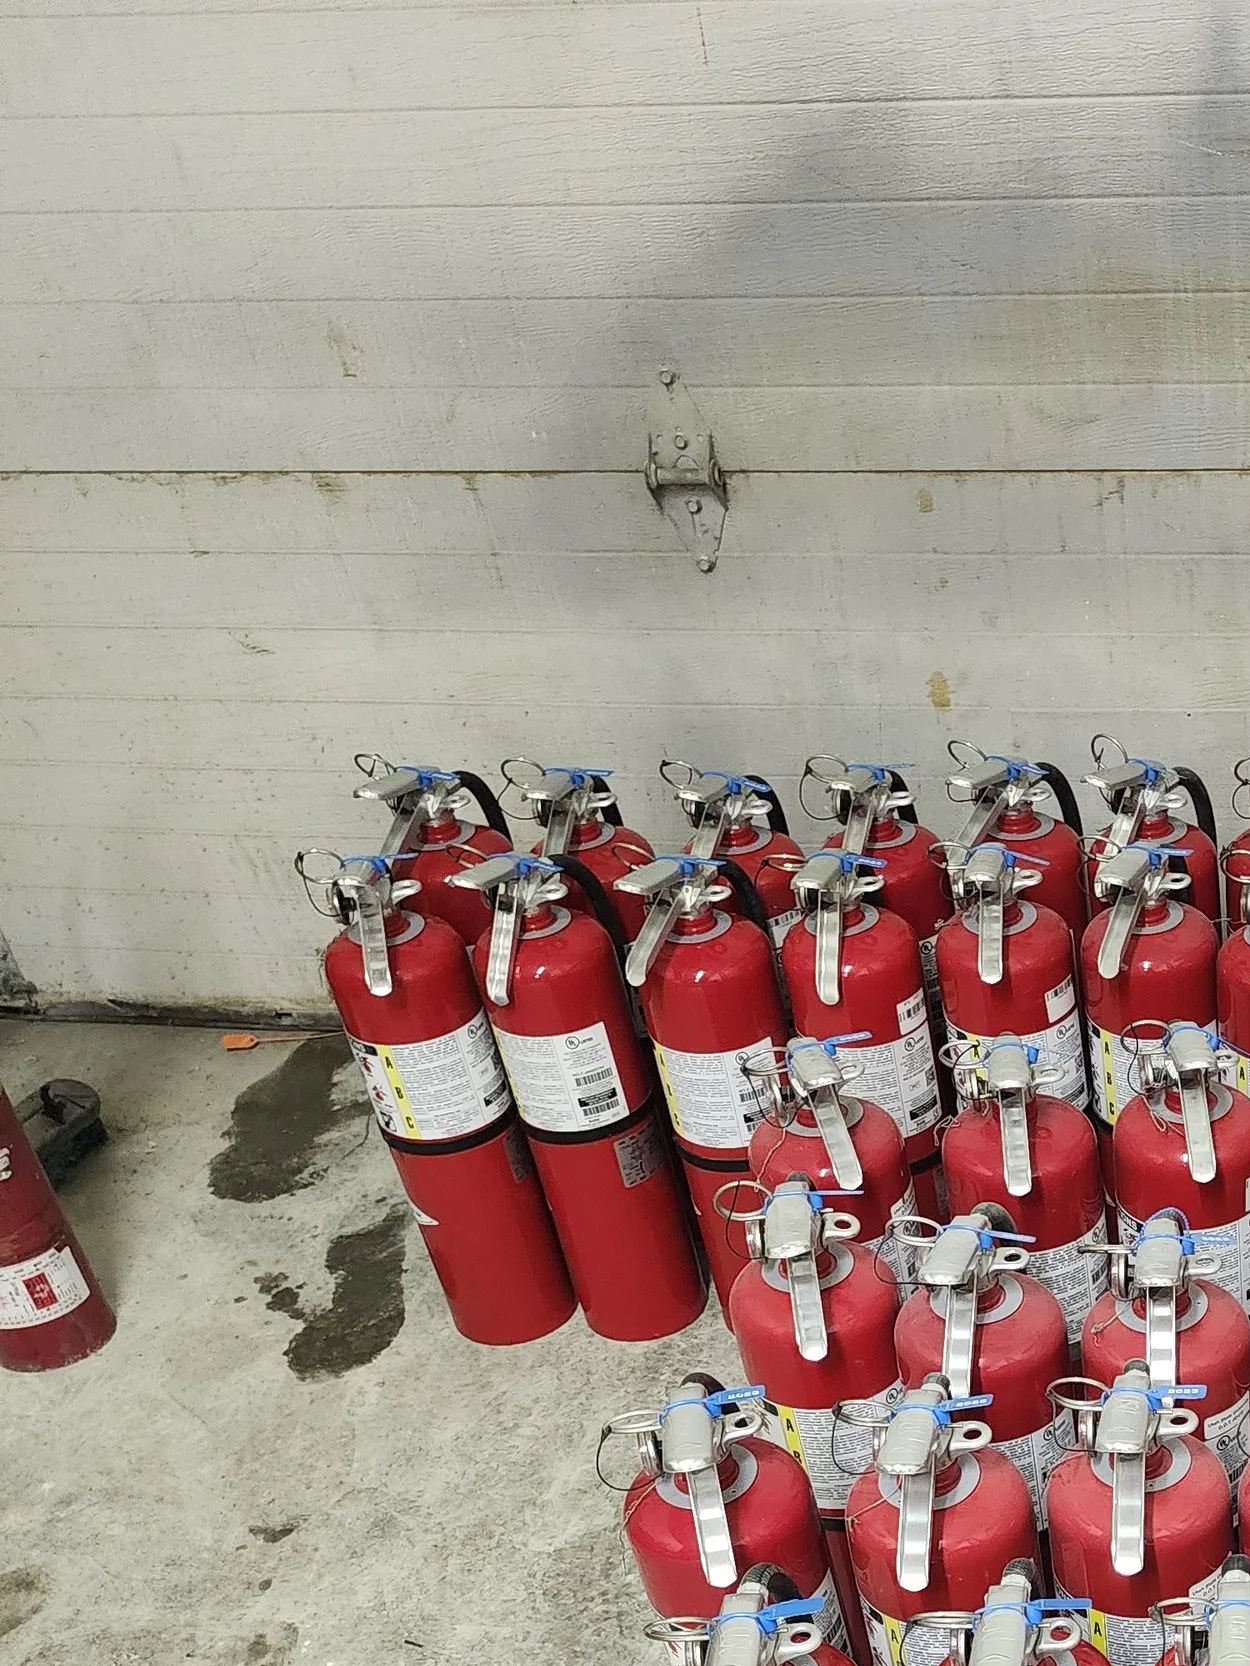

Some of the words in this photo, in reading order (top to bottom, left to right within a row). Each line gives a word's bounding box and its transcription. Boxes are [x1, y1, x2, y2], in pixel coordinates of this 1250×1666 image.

[1104, 1041, 1110, 1055] A
[385, 1056, 394, 1069] A
[1107, 1072, 1113, 1085] B
[1239, 1067, 1246, 1081] A
[394, 1086, 404, 1099] B
[1109, 1102, 1115, 1115] C
[405, 1116, 414, 1129] C
[785, 1418, 794, 1433] A
[890, 1629, 899, 1643] A
[1093, 1621, 1103, 1638] A
